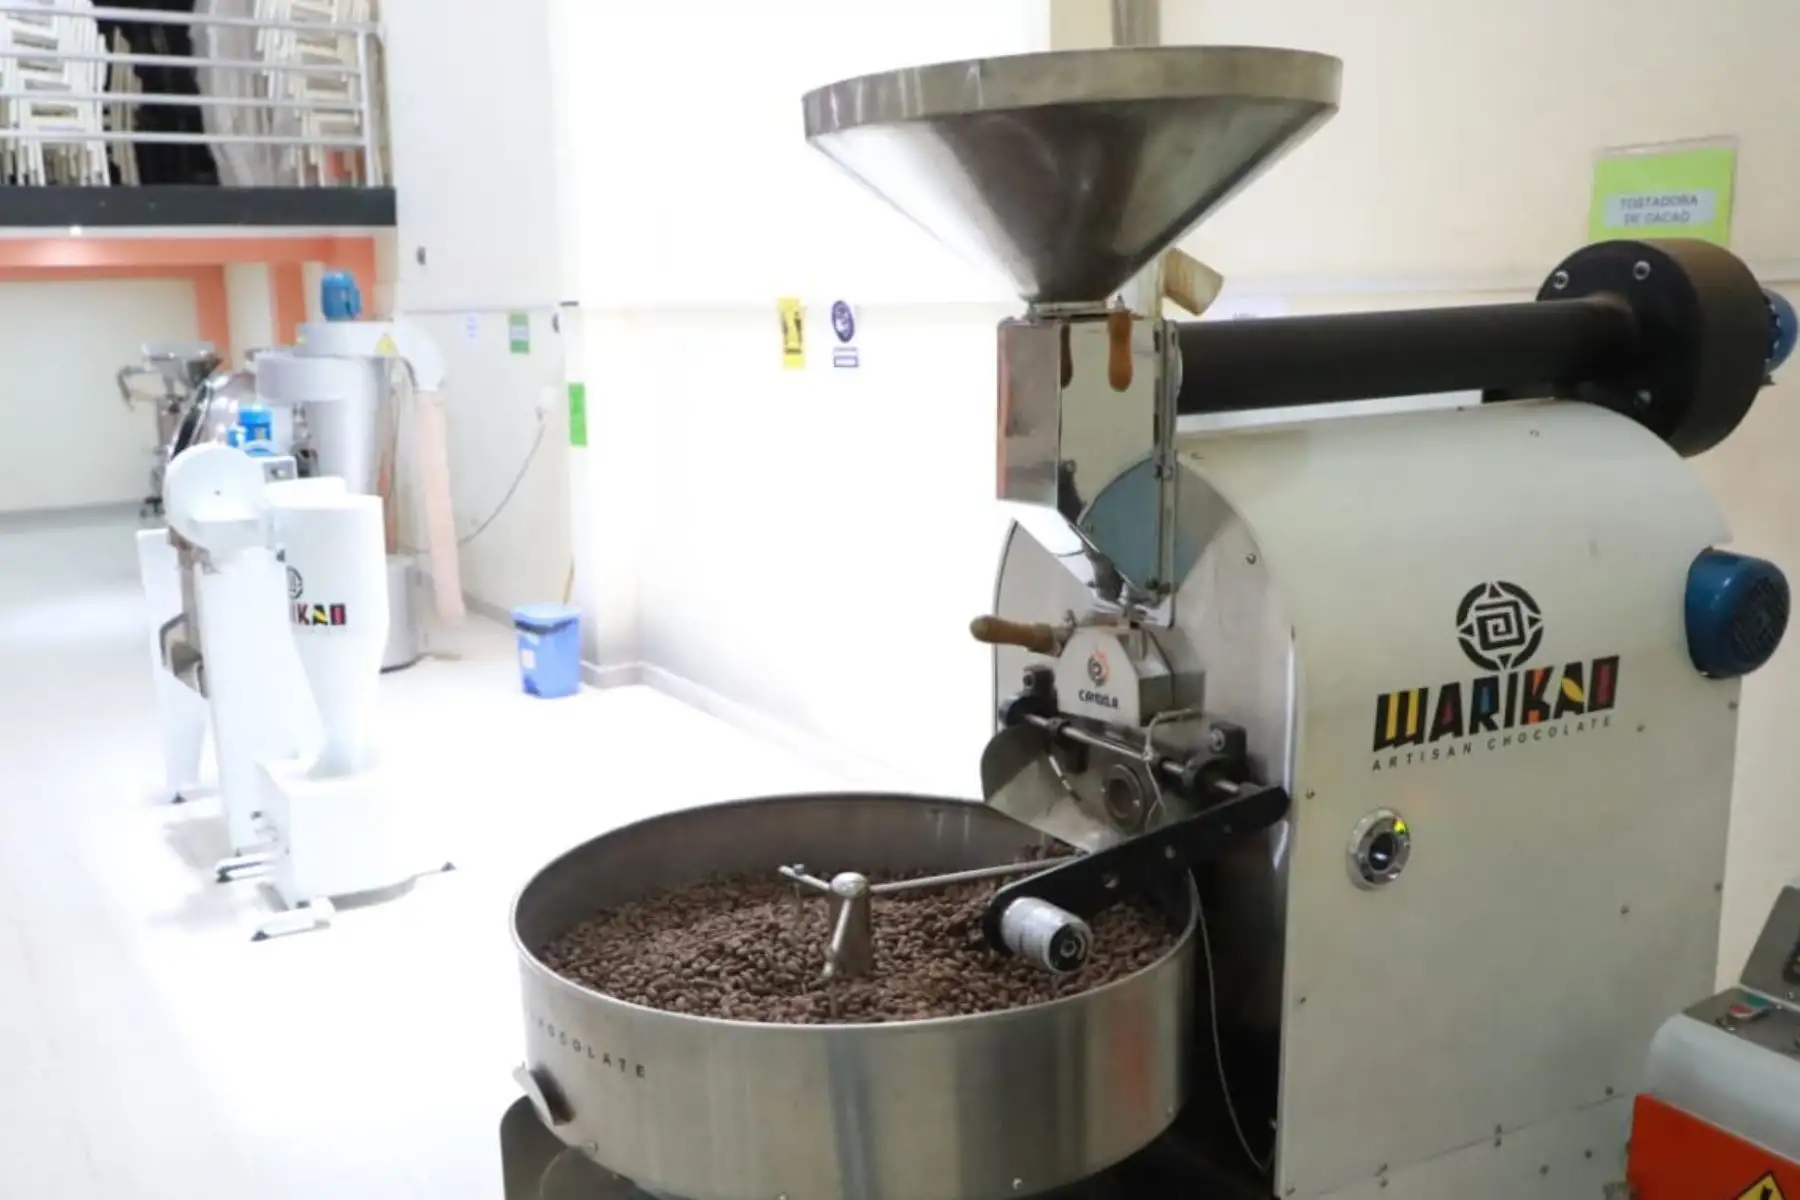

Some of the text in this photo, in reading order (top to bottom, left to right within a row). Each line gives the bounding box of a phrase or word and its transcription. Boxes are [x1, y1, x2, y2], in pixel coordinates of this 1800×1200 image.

[1620, 194, 1698, 210] TOSTADORA
[1624, 211, 1690, 226] DE CACAO
[1372, 716, 1612, 772] ARTISAN CHOCOLATE
[532, 1011, 646, 1079] HOCOLATE
